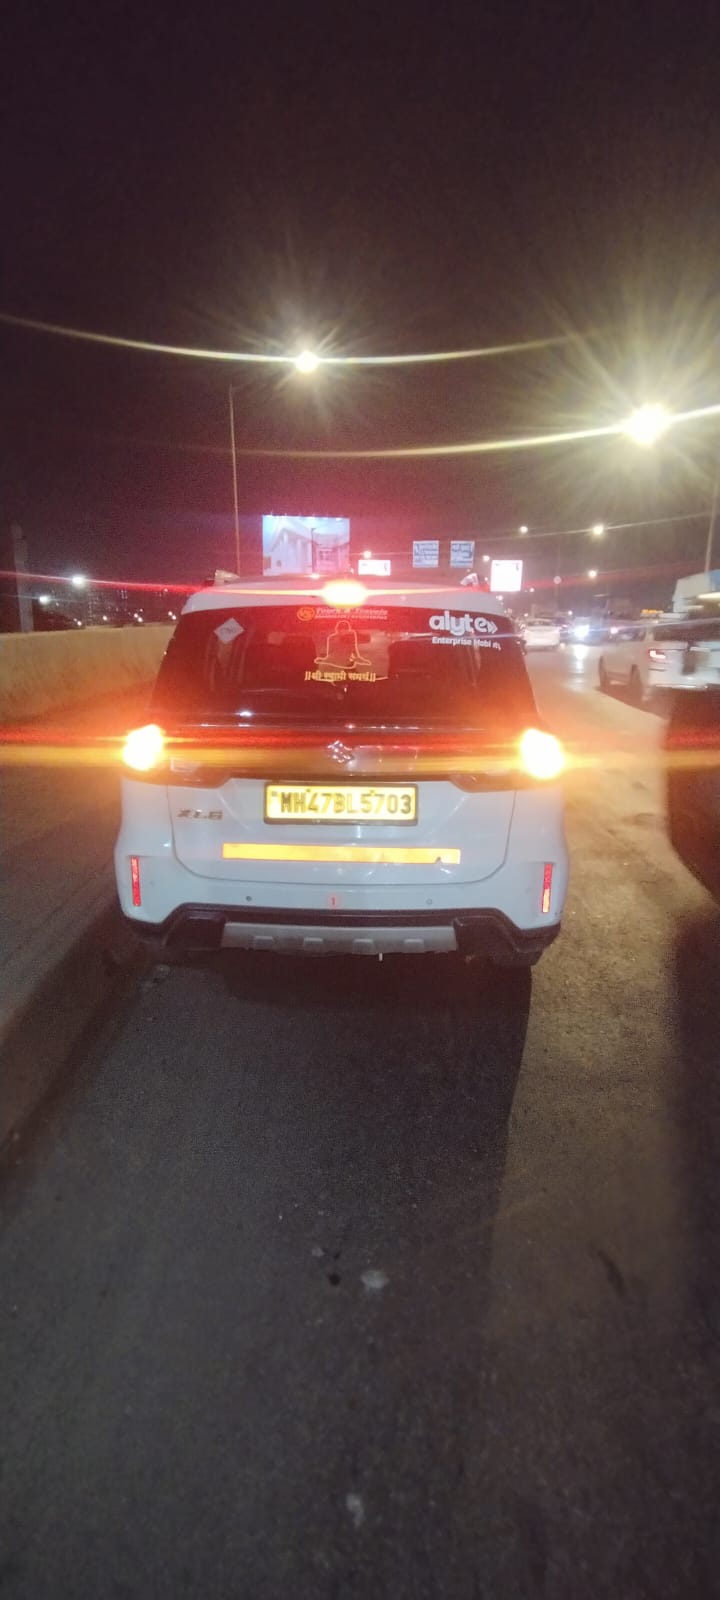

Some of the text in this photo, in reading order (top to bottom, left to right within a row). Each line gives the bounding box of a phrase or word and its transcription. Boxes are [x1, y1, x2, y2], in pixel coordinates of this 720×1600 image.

[429, 610, 487, 636] alyte
[432, 637, 472, 647] Enterprise
[280, 791, 412, 815] MH47BL5703
